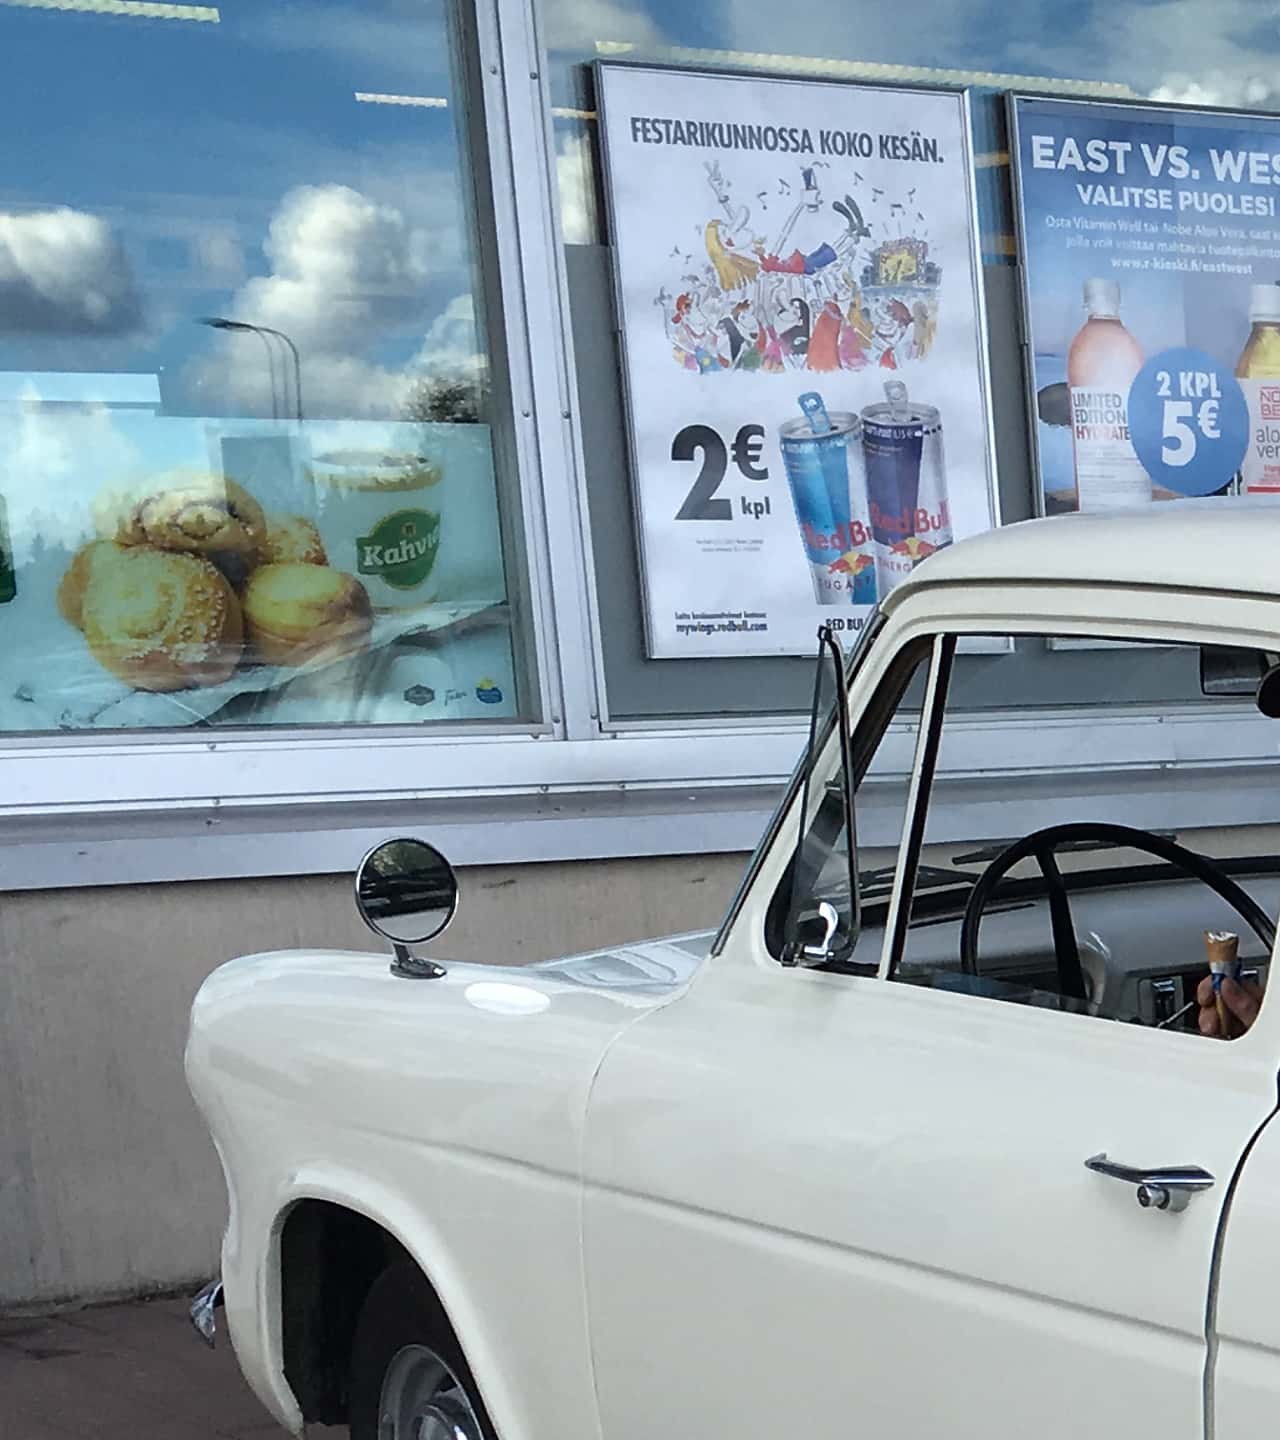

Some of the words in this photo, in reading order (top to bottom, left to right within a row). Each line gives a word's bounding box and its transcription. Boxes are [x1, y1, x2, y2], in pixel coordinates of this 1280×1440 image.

[630, 116, 815, 155] FESTARIKUNNOSSA
[819, 128, 873, 159] KOKO
[879, 131, 944, 164] KESÄN.
[1031, 135, 1132, 175] EAST
[1141, 143, 1200, 180] VS.
[1076, 184, 1174, 211] VALITSE
[1156, 370, 1172, 397] 2
[1179, 371, 1222, 398] KPL
[1074, 409, 1127, 424] EDITION
[1161, 399, 1222, 467] 5€
[671, 424, 769, 522] 2€
[741, 496, 772, 520] kpl
